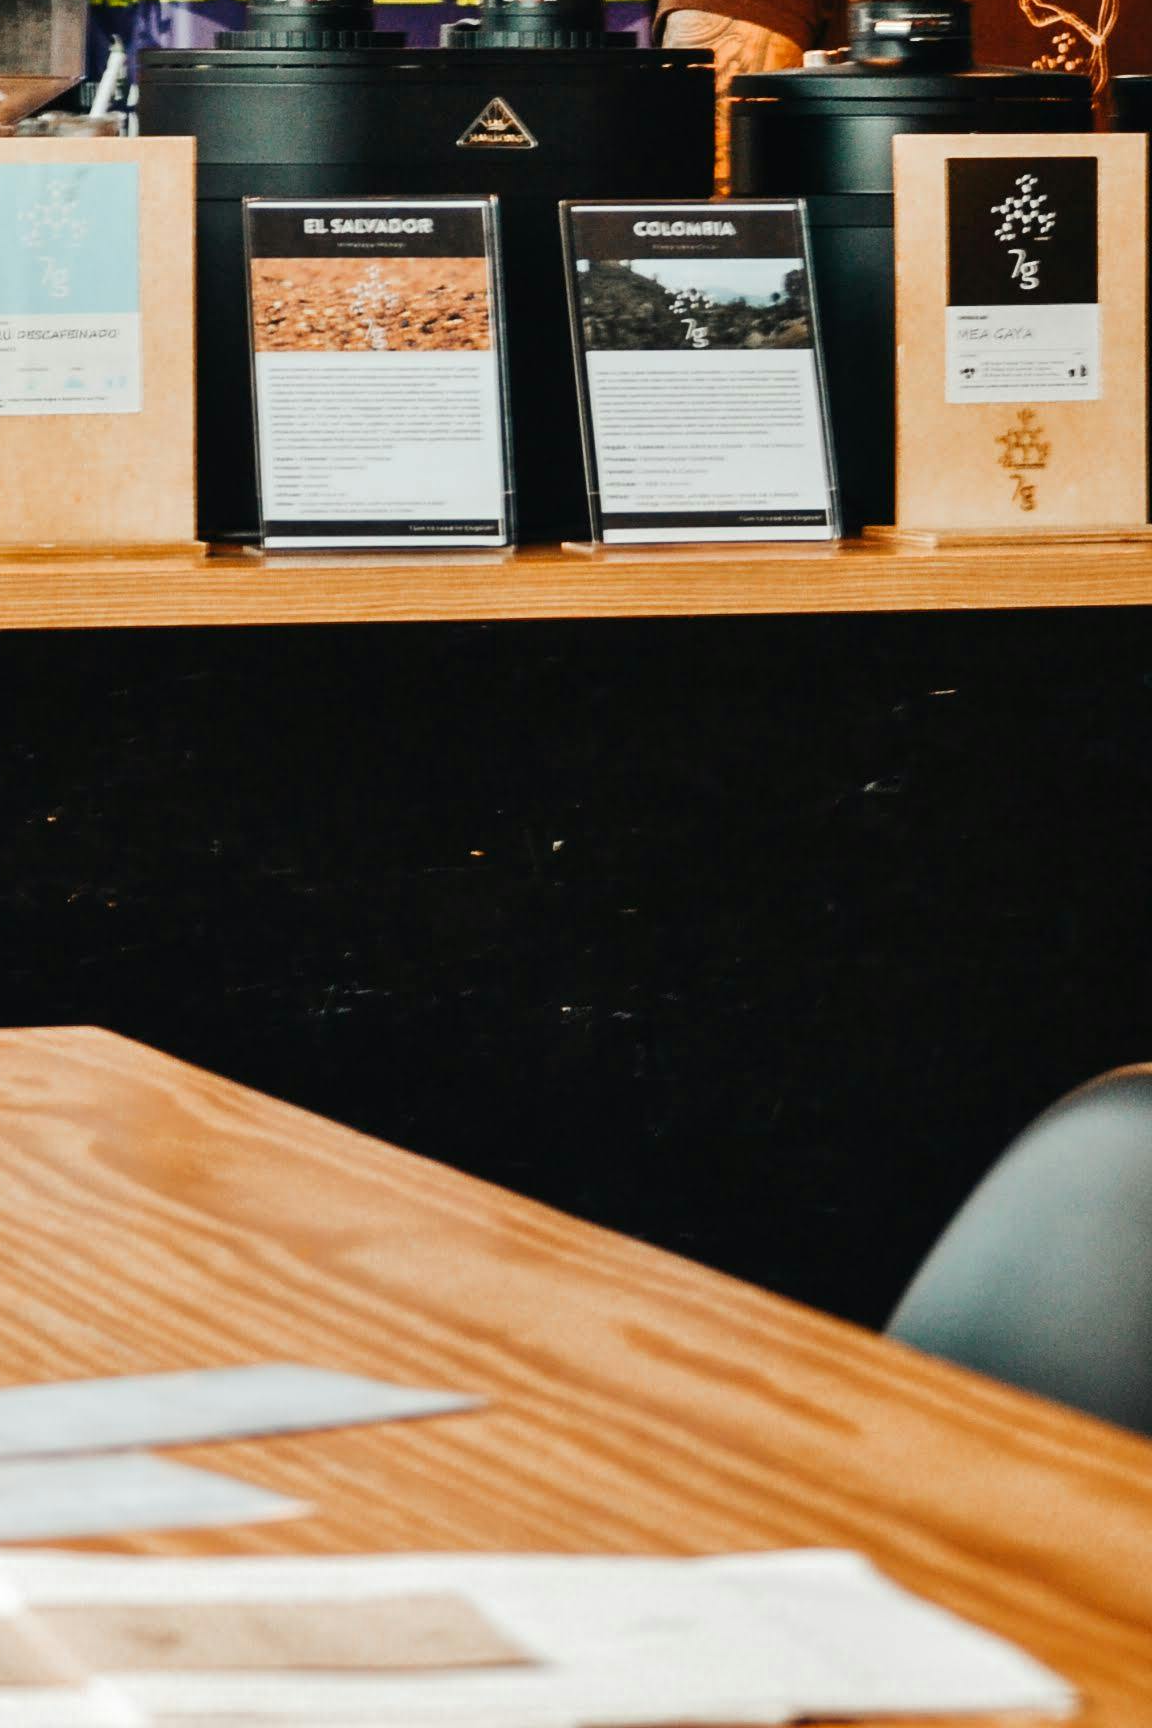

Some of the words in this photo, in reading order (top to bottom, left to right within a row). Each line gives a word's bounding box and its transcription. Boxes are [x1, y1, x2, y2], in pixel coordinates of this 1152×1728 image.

[303, 218, 329, 234] EL
[330, 218, 435, 234] SALVADOR
[633, 221, 737, 237] COLOMBIA
[1007, 248, 1041, 290] 7g
[17, 328, 118, 341] DESCAFEINADO
[681, 318, 710, 348] 7g
